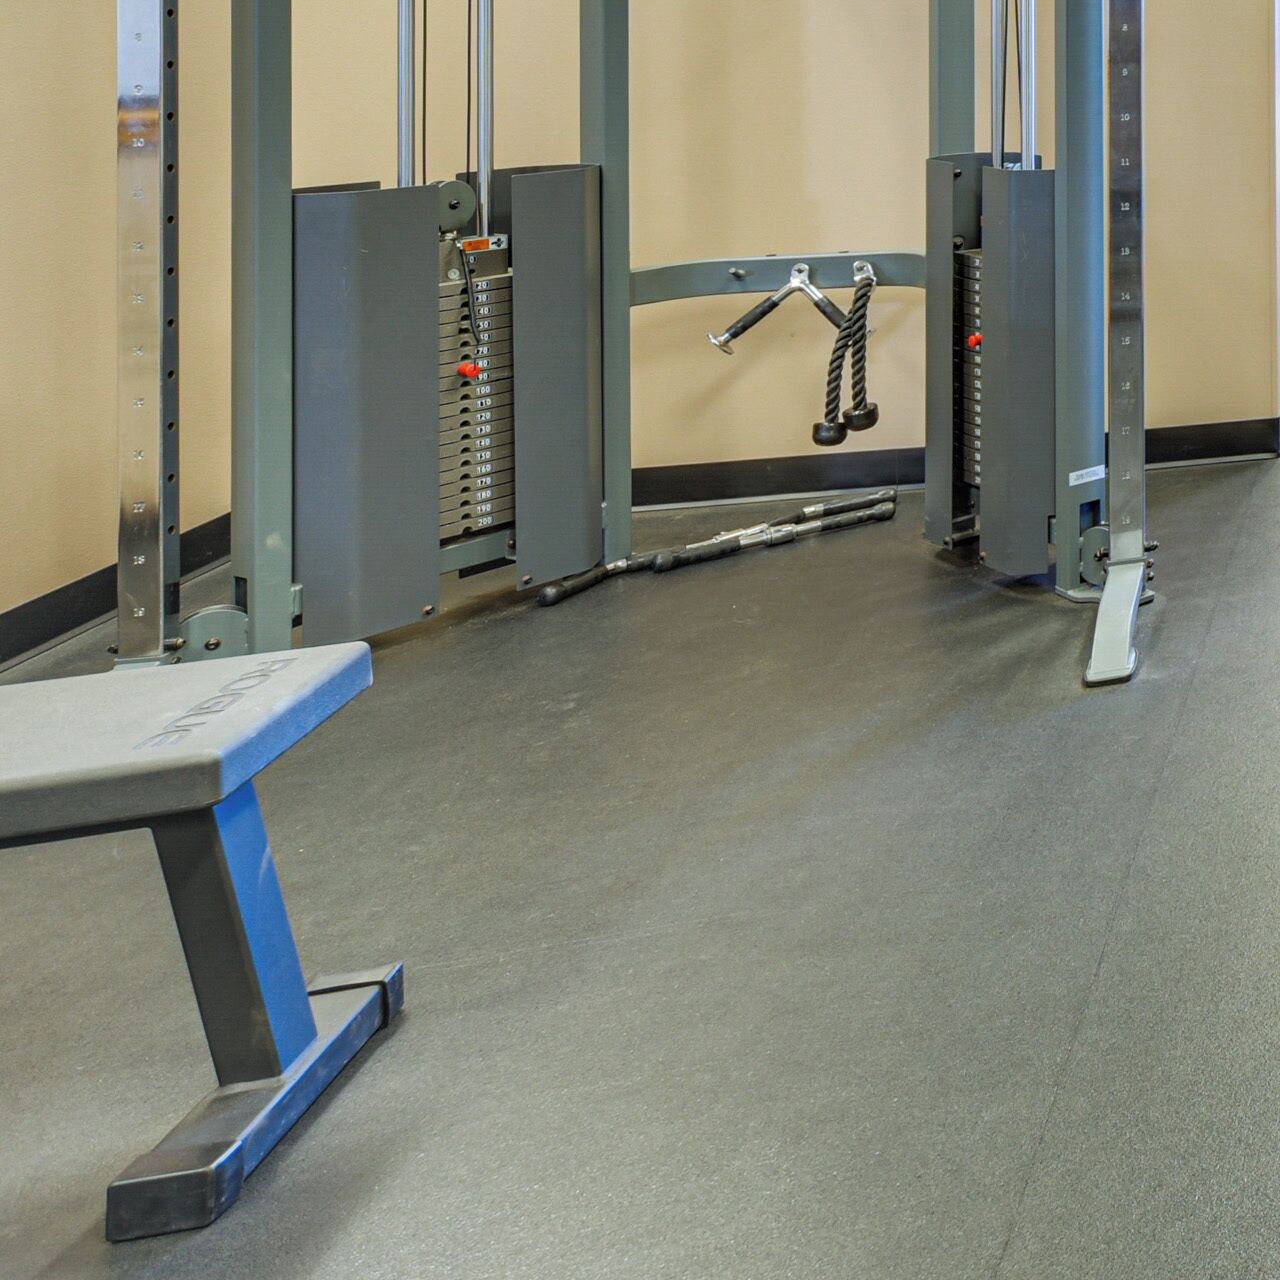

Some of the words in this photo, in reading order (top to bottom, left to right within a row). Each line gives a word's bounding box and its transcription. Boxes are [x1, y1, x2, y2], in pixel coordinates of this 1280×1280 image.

[1120, 113, 1130, 121] 10
[132, 138, 145, 148] 10
[1120, 158, 1130, 166] 11
[1120, 202, 1130, 210] 12
[477, 282, 487, 290] 20
[479, 307, 489, 315] 40
[480, 321, 489, 329] 50
[476, 386, 491, 395] 100
[477, 399, 491, 408] 110
[476, 412, 491, 420] 120
[476, 425, 491, 434] 130
[476, 439, 491, 447] 140
[477, 452, 491, 460] 150
[477, 464, 492, 473] 160
[477, 477, 492, 487] 170
[477, 504, 492, 513] 190
[478, 517, 492, 526] 200
[131, 657, 299, 751] ROGUE
